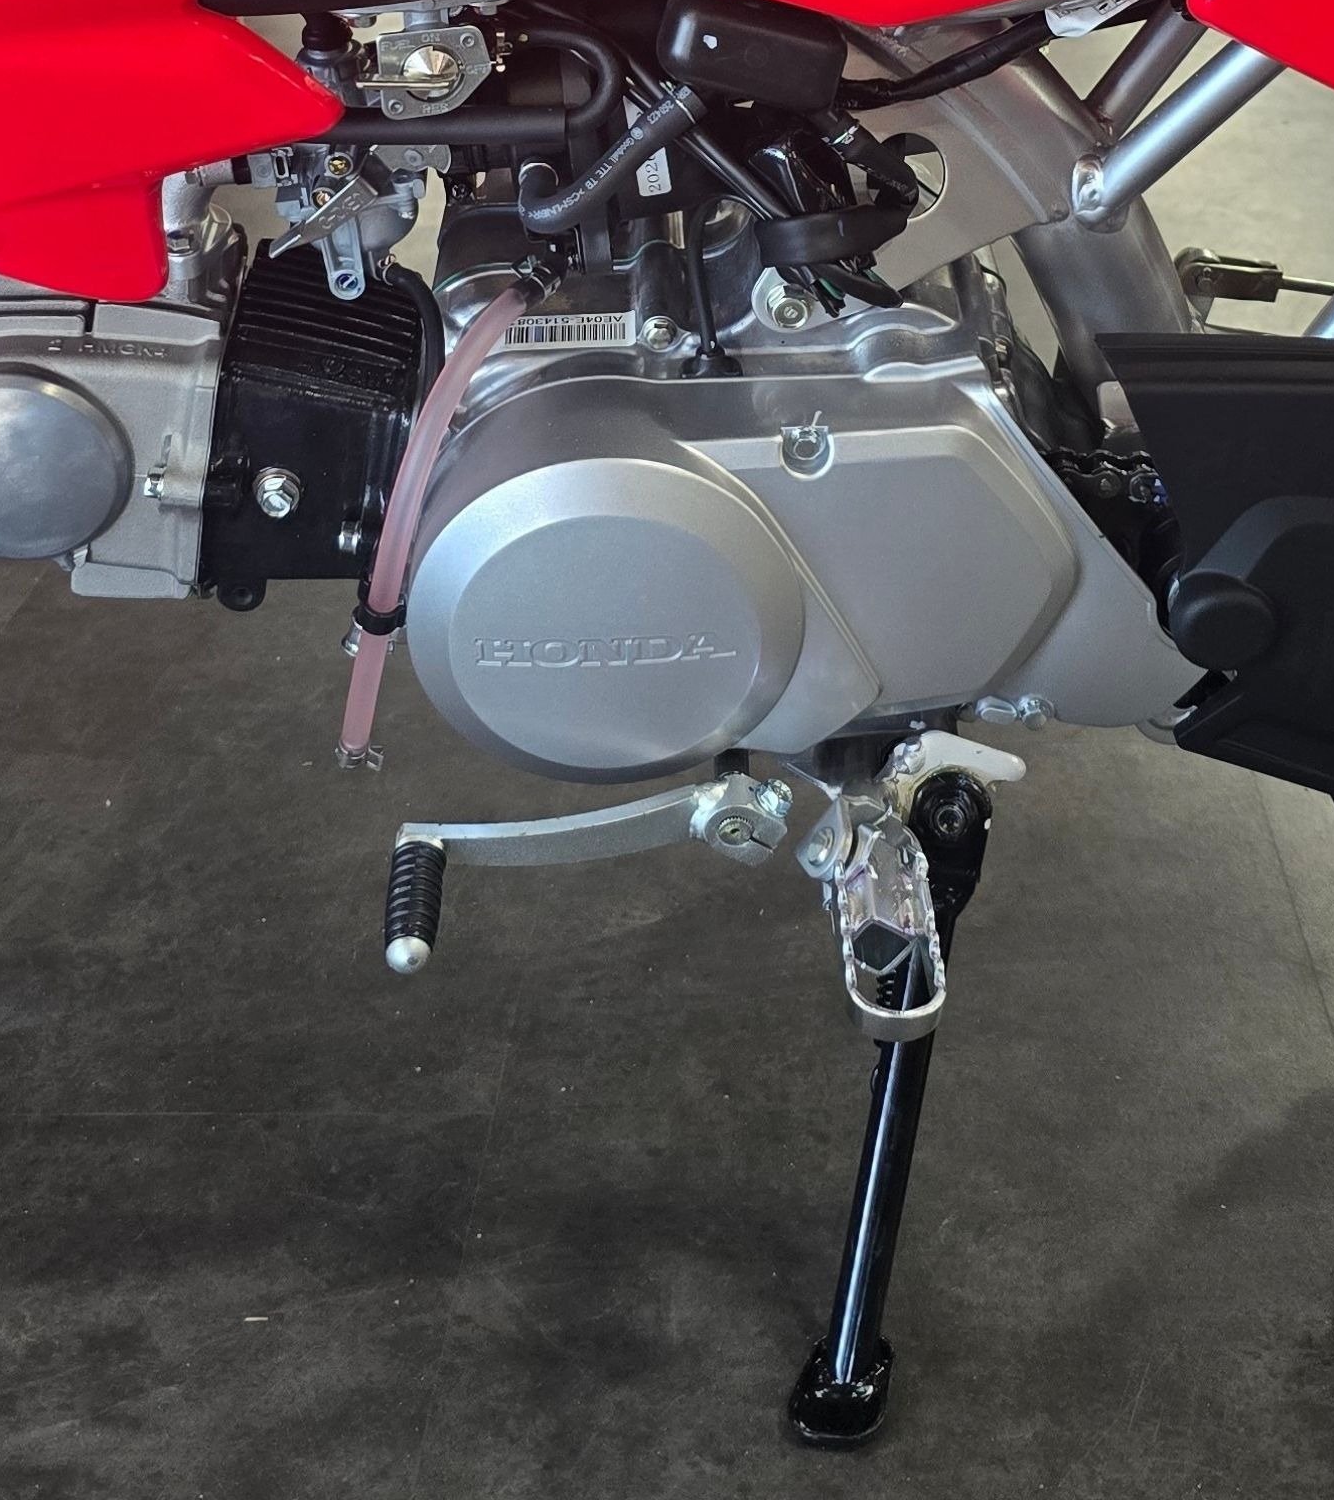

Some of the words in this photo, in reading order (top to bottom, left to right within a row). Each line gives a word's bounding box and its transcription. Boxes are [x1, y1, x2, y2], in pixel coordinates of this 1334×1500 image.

[421, 33, 440, 43] ON
[380, 41, 417, 51] FUEL
[509, 315, 624, 326] AE04E-514308
[474, 631, 737, 668] HONDA
